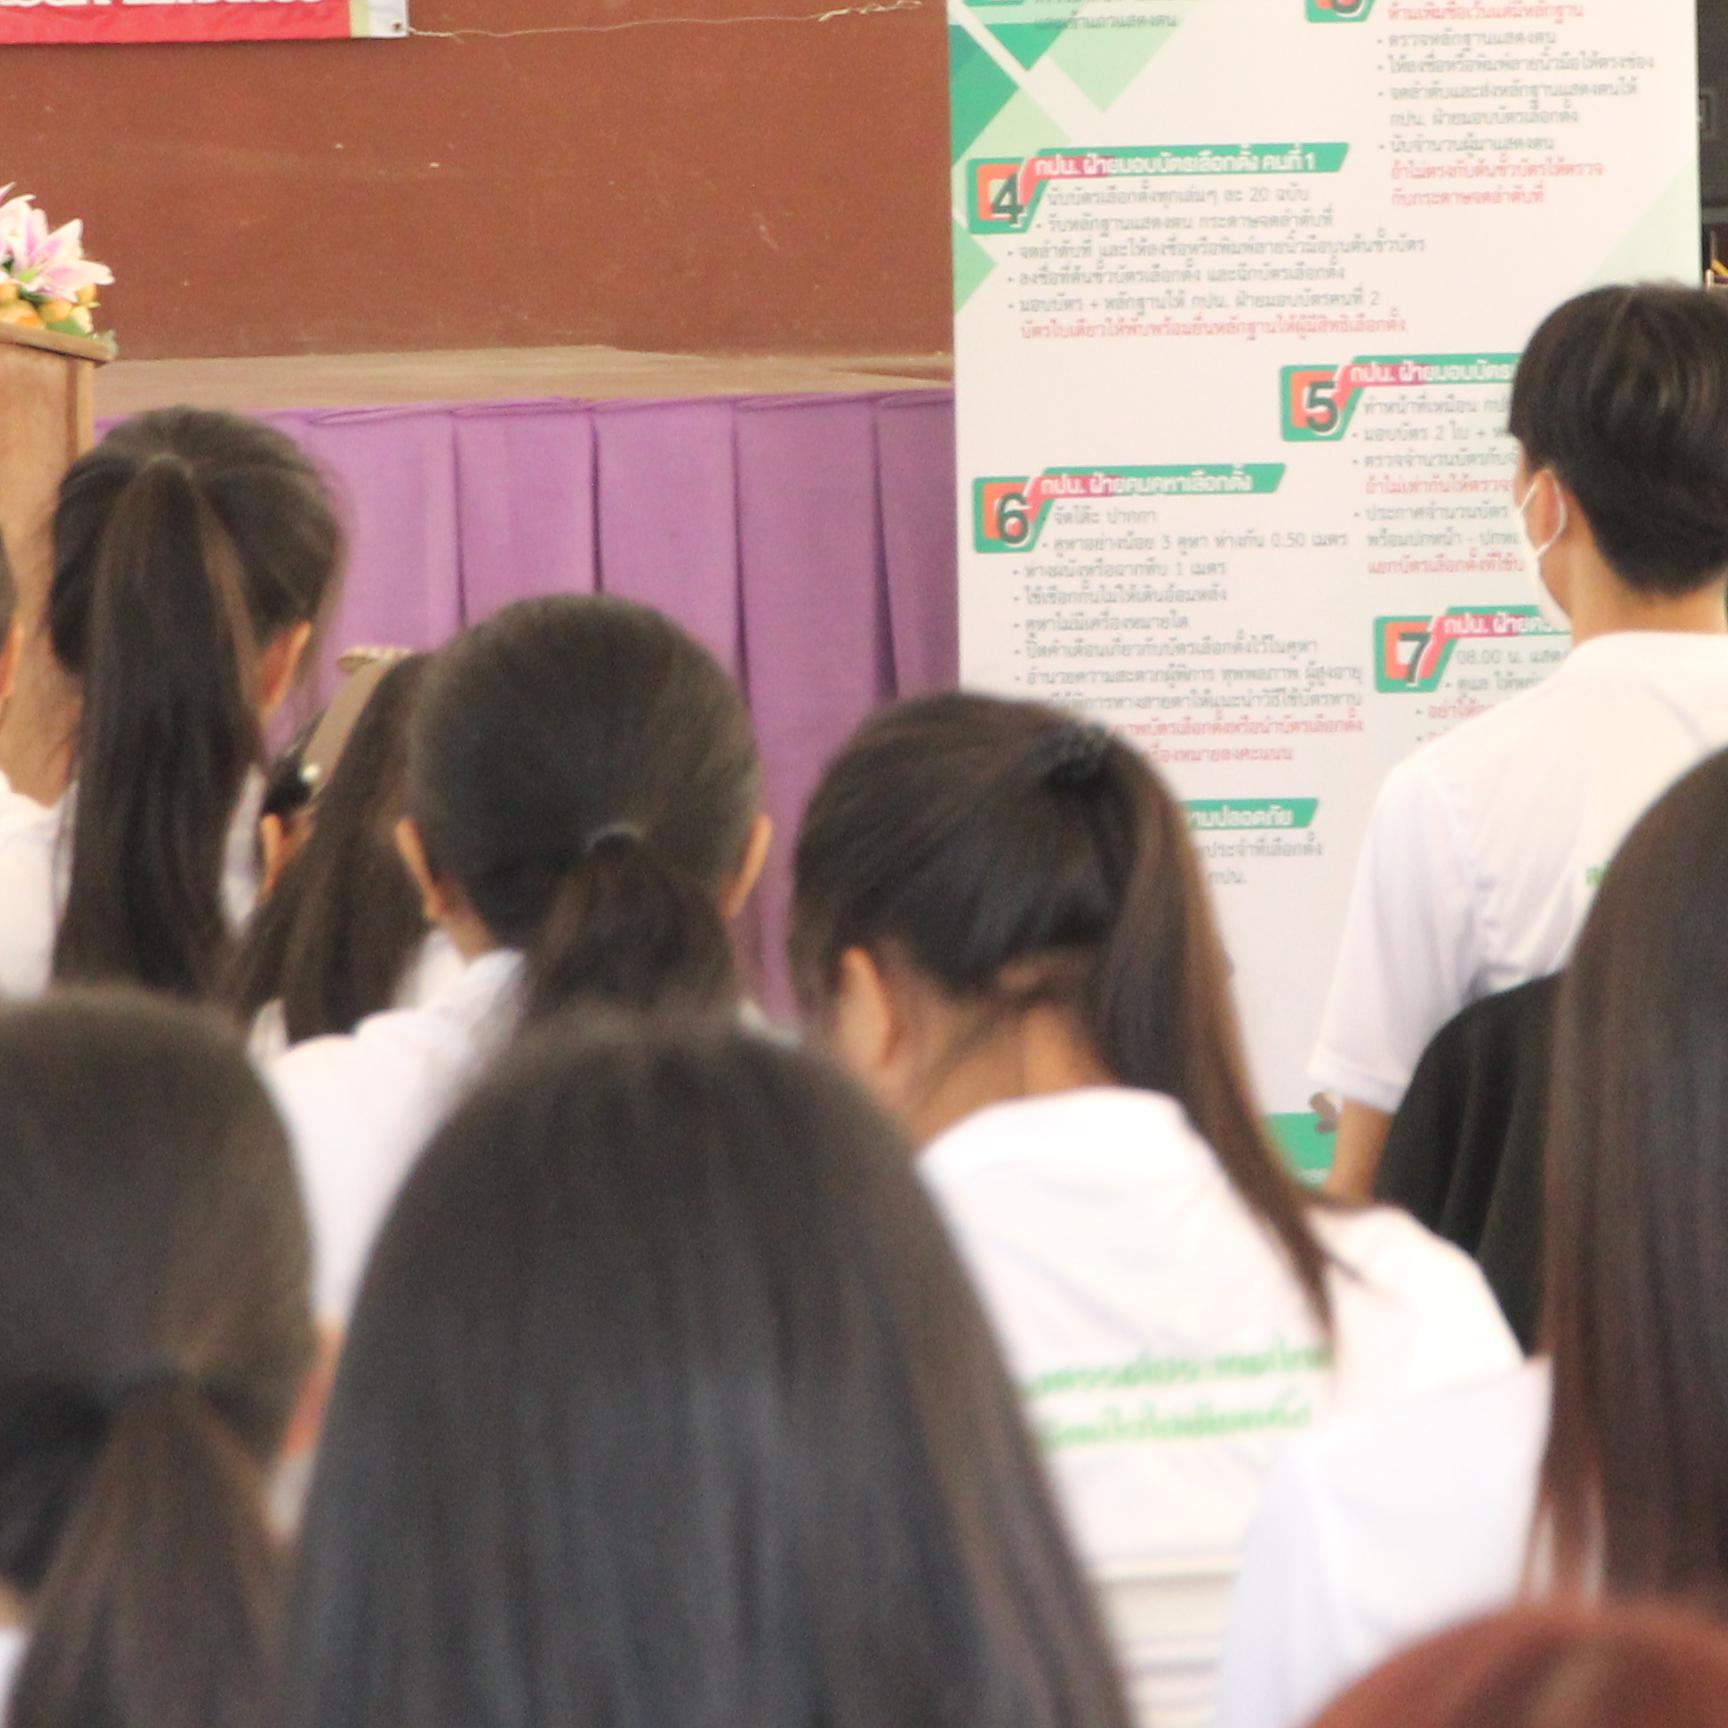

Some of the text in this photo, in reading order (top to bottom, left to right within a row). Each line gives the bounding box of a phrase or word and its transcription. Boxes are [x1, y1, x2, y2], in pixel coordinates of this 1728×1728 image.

[990, 176, 1025, 228] 4
[1034, 155, 1078, 177] กปน.
[1250, 186, 1269, 203] 20
[1370, 290, 1382, 307] 2
[1304, 358, 1512, 436] 5 กปน. ฝ่ายมอบบัตร
[994, 491, 1031, 545] 6
[1040, 474, 1087, 496] กปน.
[1161, 532, 1171, 551] 3
[1271, 532, 1306, 549] 0.50
[1175, 559, 1184, 577] 1
[1399, 632, 1432, 688] 7
[1443, 612, 1490, 634] กปน.
[1456, 648, 1501, 665] 08.00
[1190, 803, 1294, 827] ามปลอดภัย
